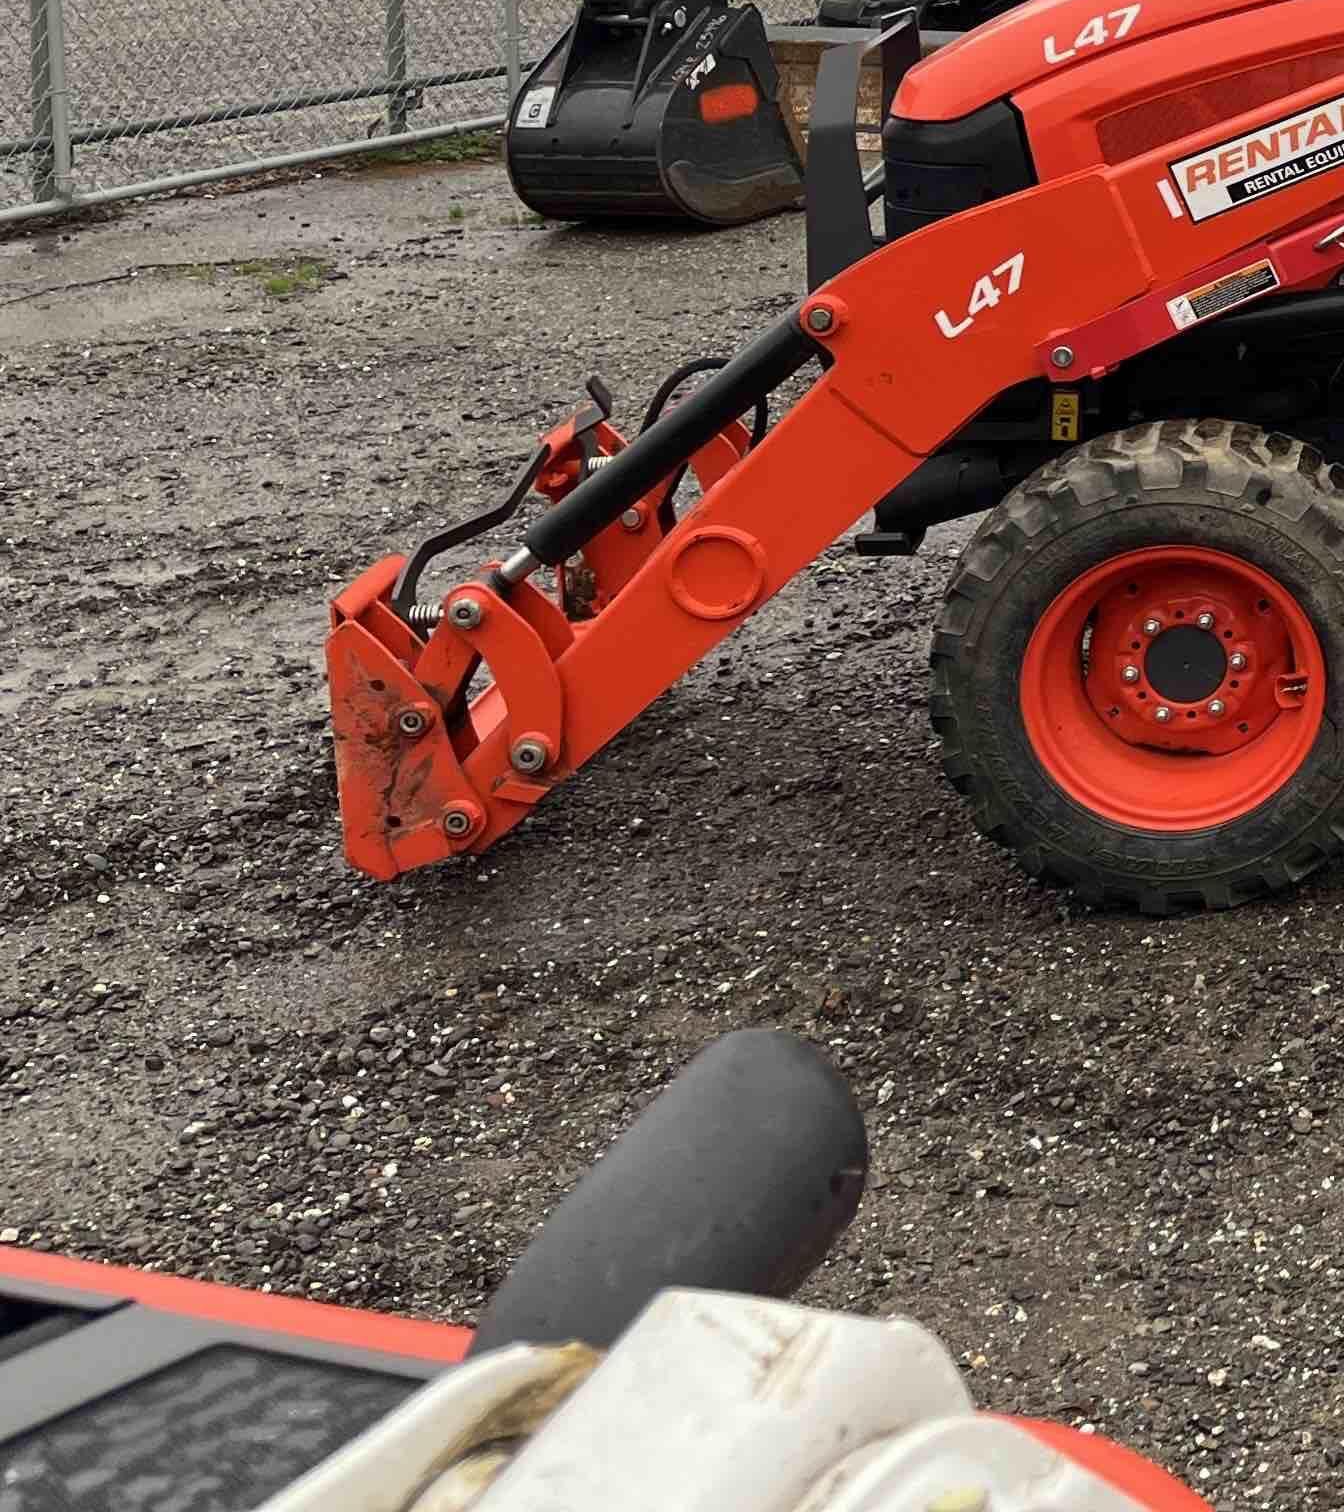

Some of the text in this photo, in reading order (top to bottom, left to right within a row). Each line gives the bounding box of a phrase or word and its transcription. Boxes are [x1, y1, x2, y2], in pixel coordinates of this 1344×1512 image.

[1043, 3, 1142, 65] L47
[1244, 164, 1305, 195] RENTAL
[933, 251, 1025, 339] L47
